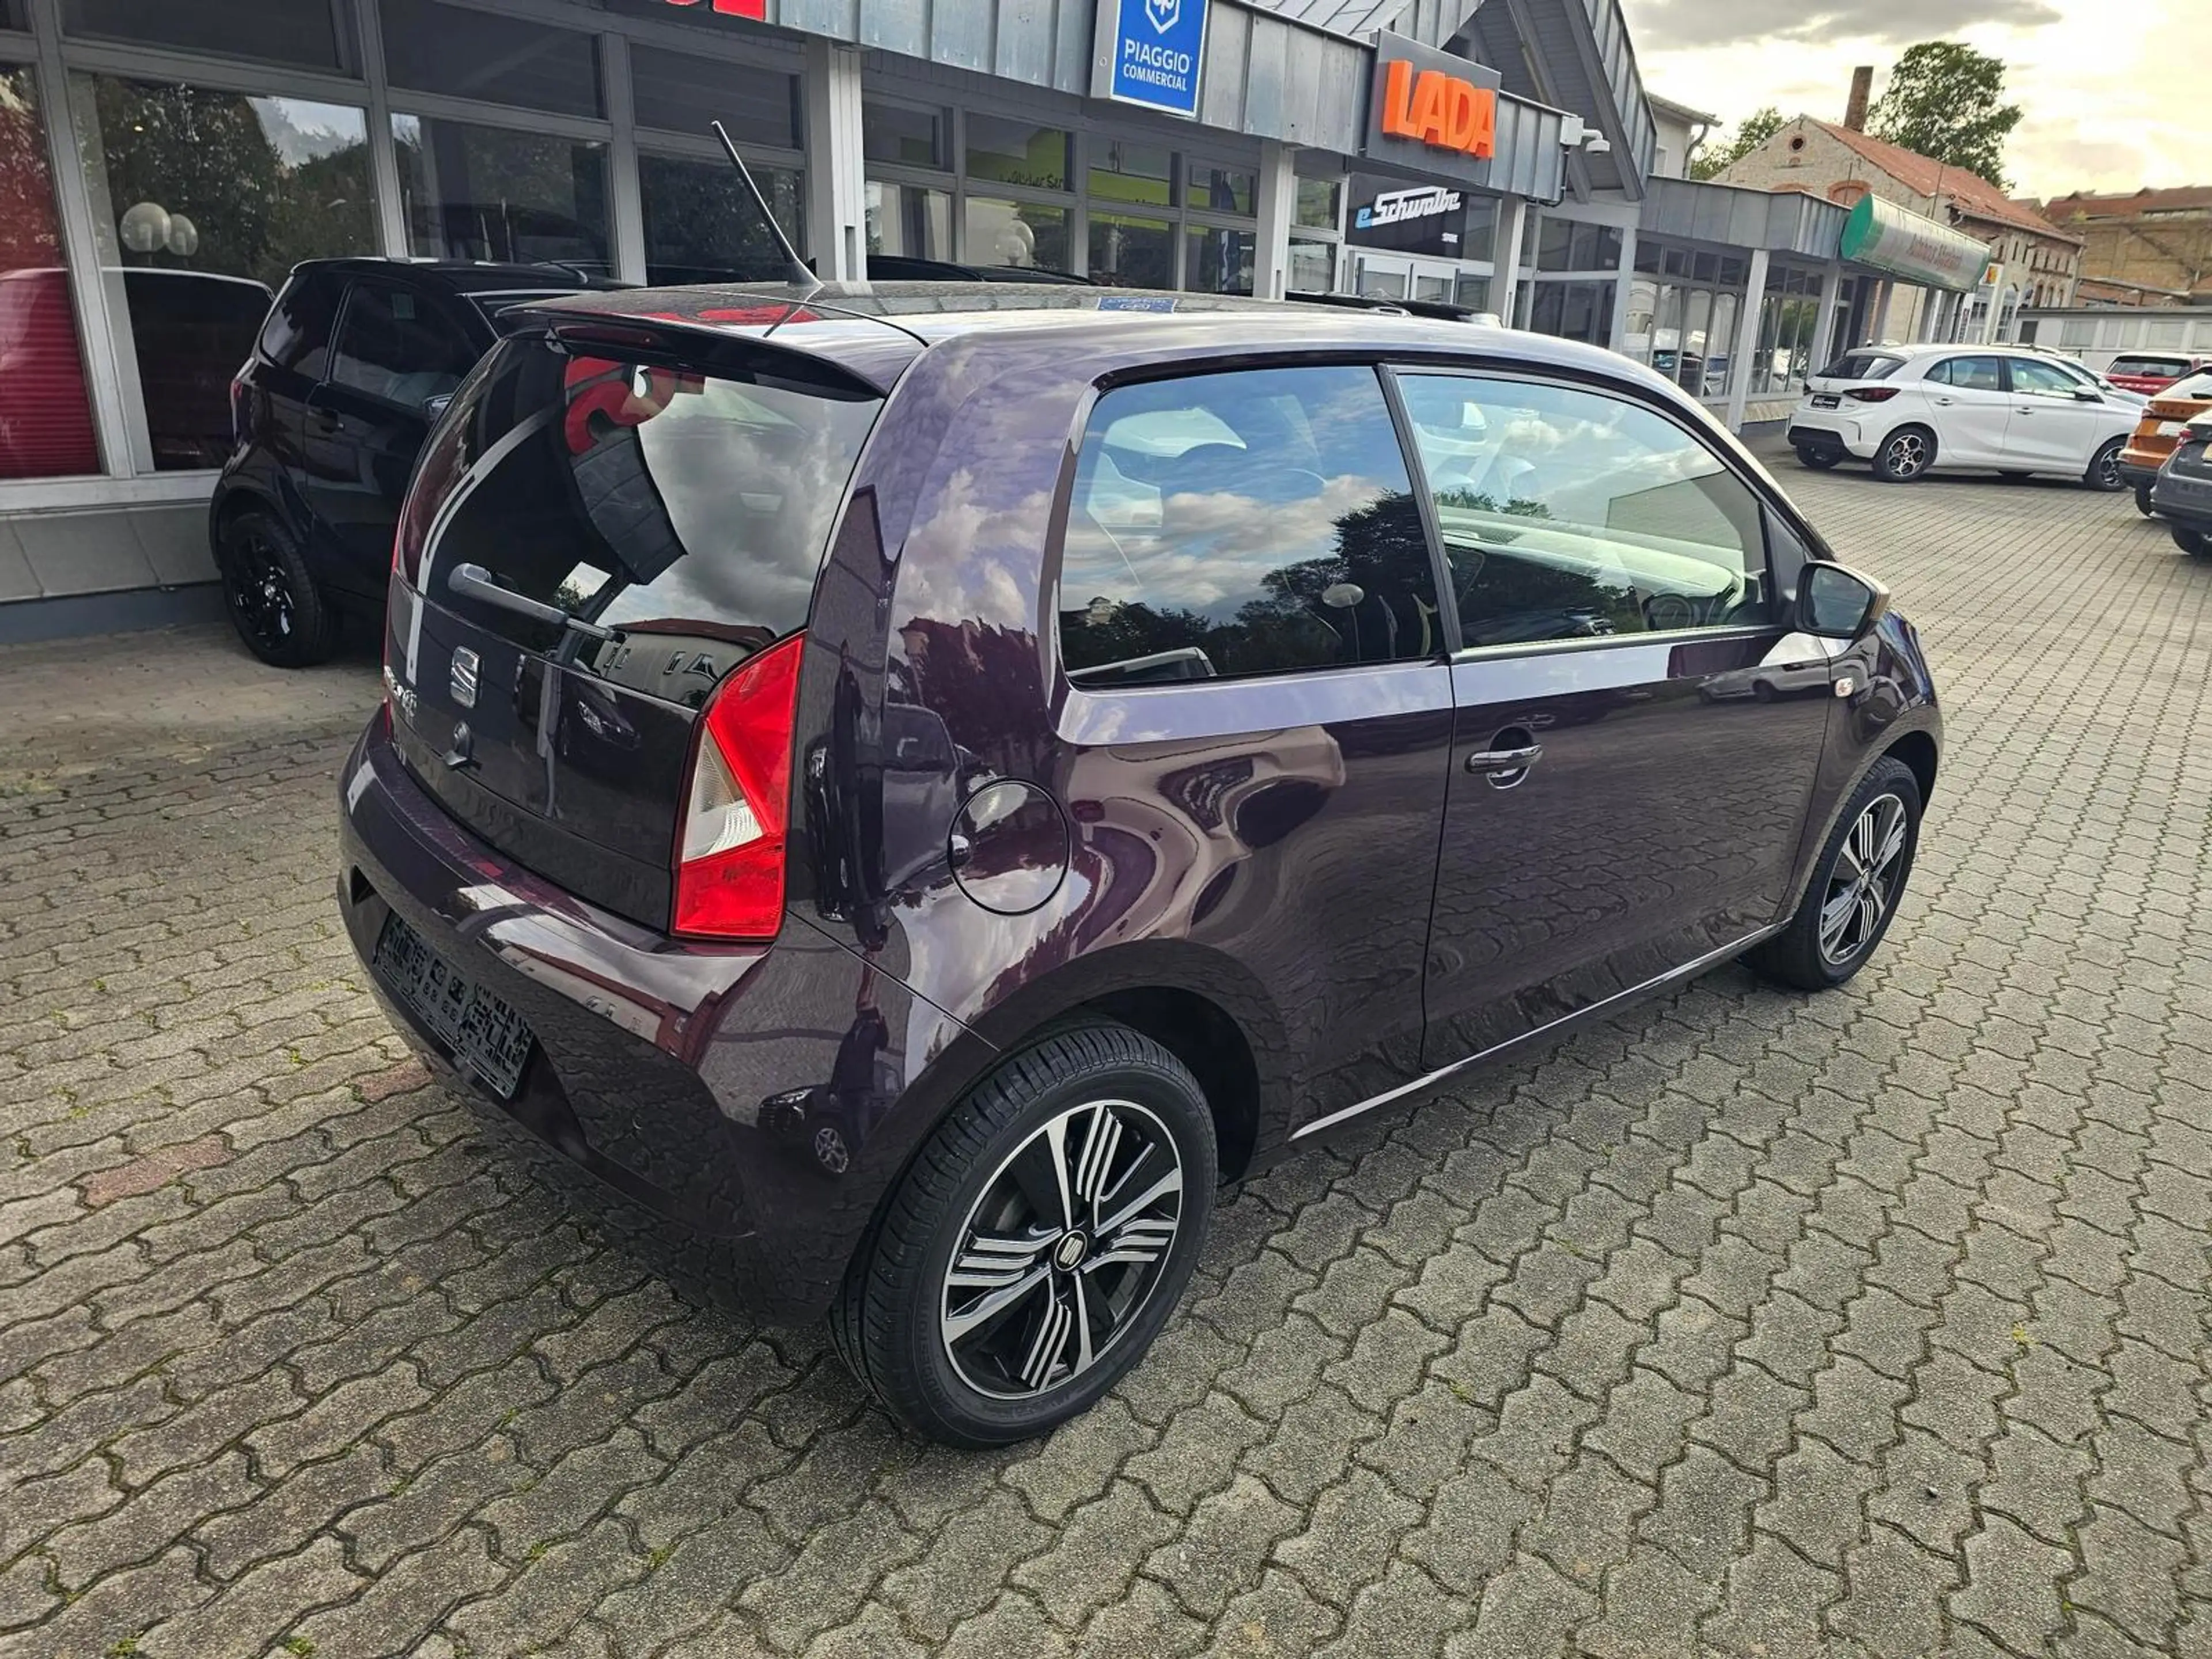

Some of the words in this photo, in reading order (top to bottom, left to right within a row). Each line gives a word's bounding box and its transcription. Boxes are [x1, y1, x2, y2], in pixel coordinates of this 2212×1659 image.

[1124, 37, 1190, 74] PIAGGIO
[1123, 63, 1187, 92] COMMERCIAL
[1382, 59, 1495, 158] LADA
